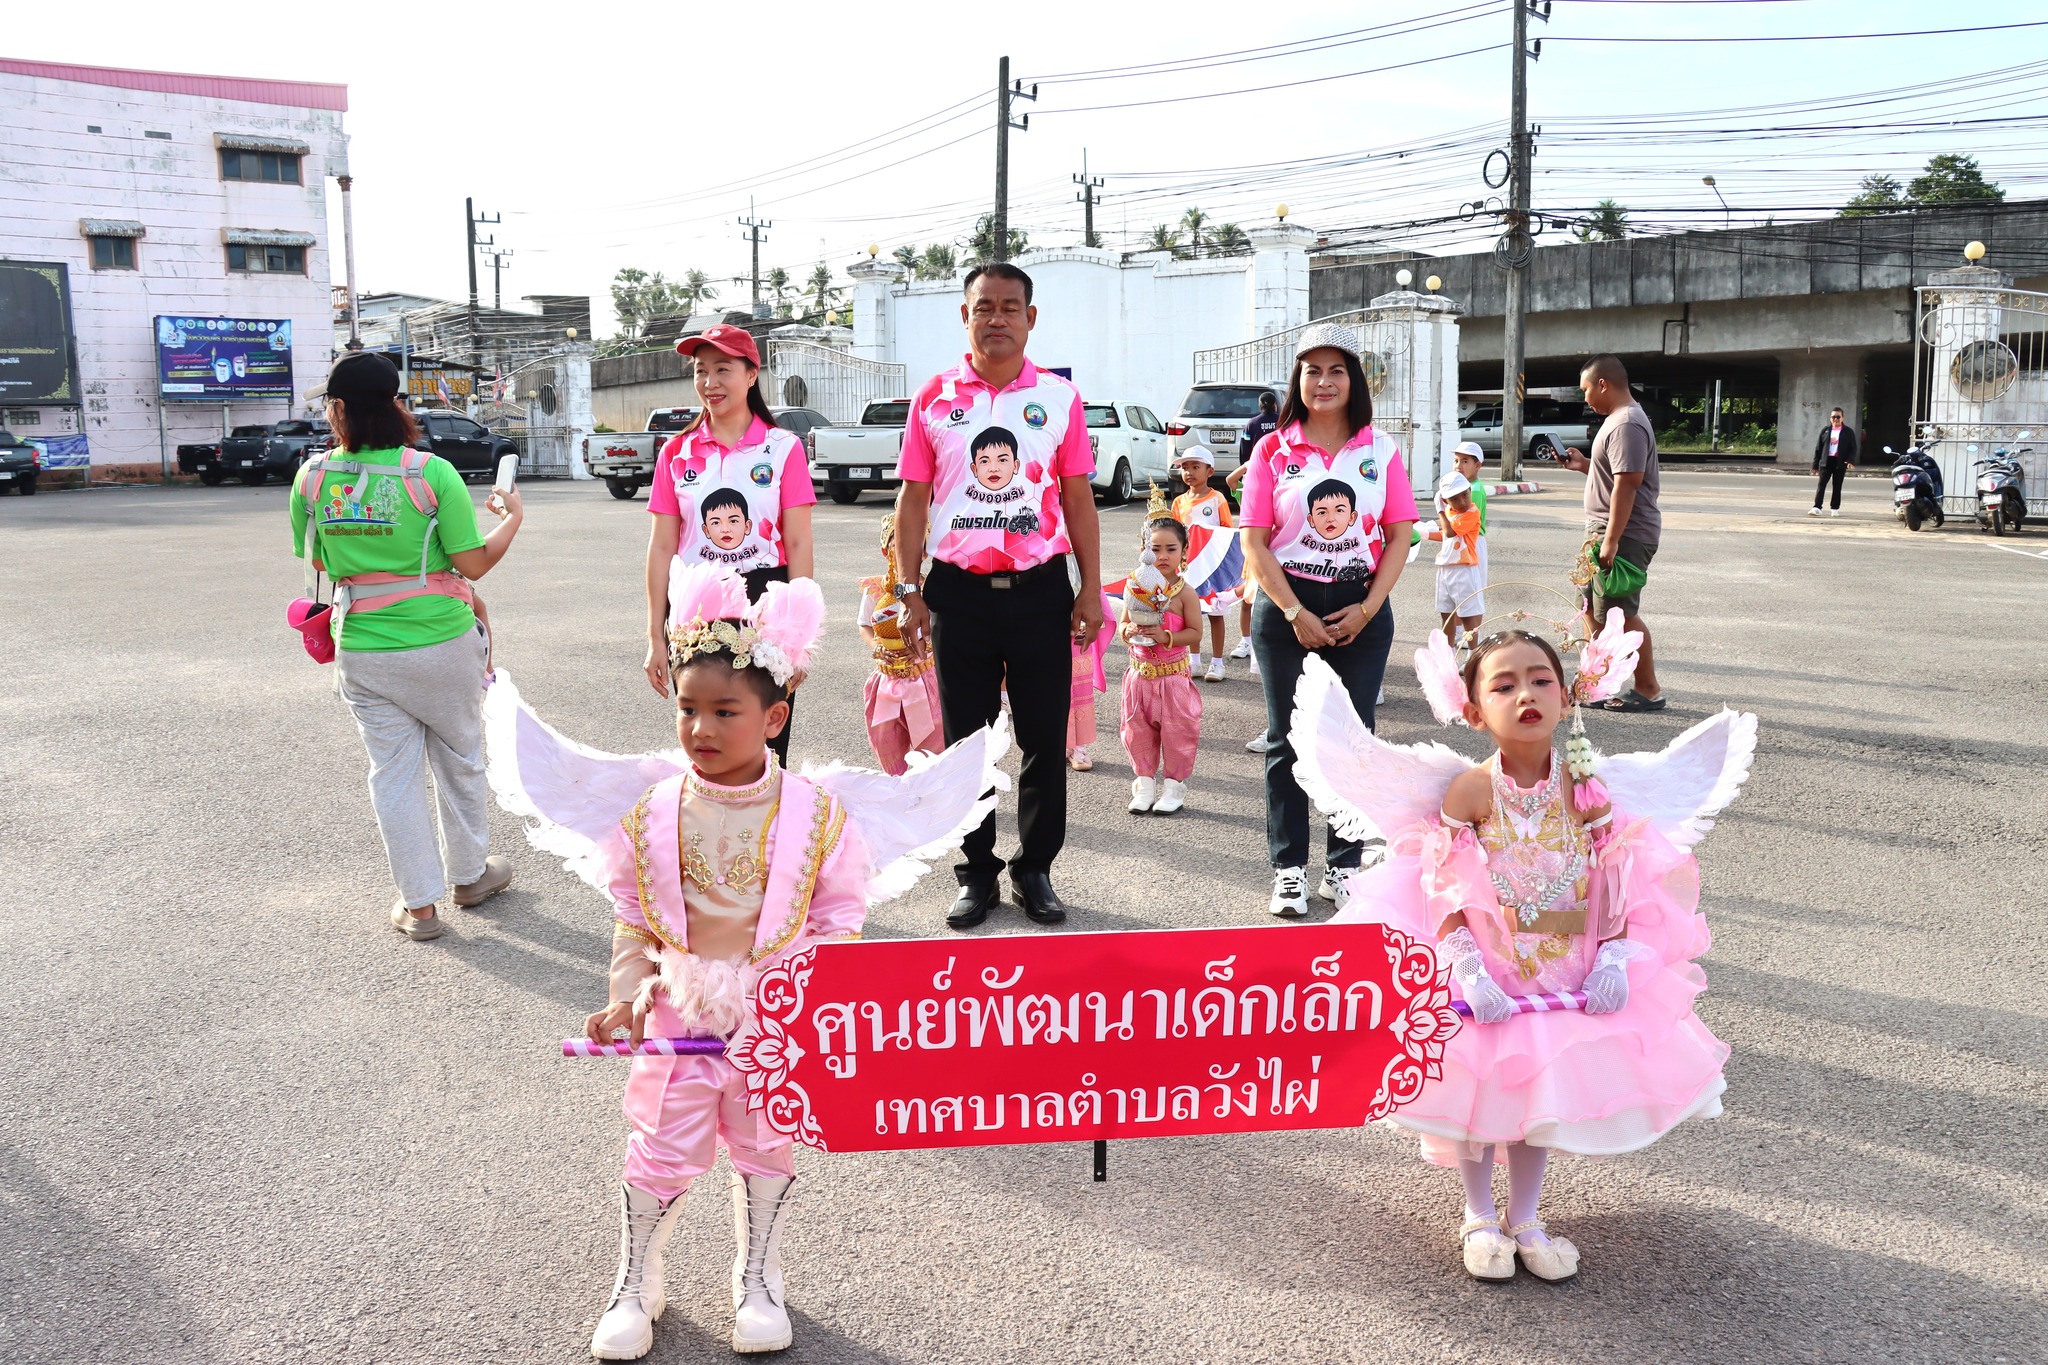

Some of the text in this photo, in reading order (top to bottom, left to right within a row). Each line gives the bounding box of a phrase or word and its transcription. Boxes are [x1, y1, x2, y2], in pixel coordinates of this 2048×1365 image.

[812, 950, 1384, 1079] ศูนย์พัฒนาเด็กเล็ก
[874, 1056, 1322, 1136] เทศบาลตำบลวังไผ่
